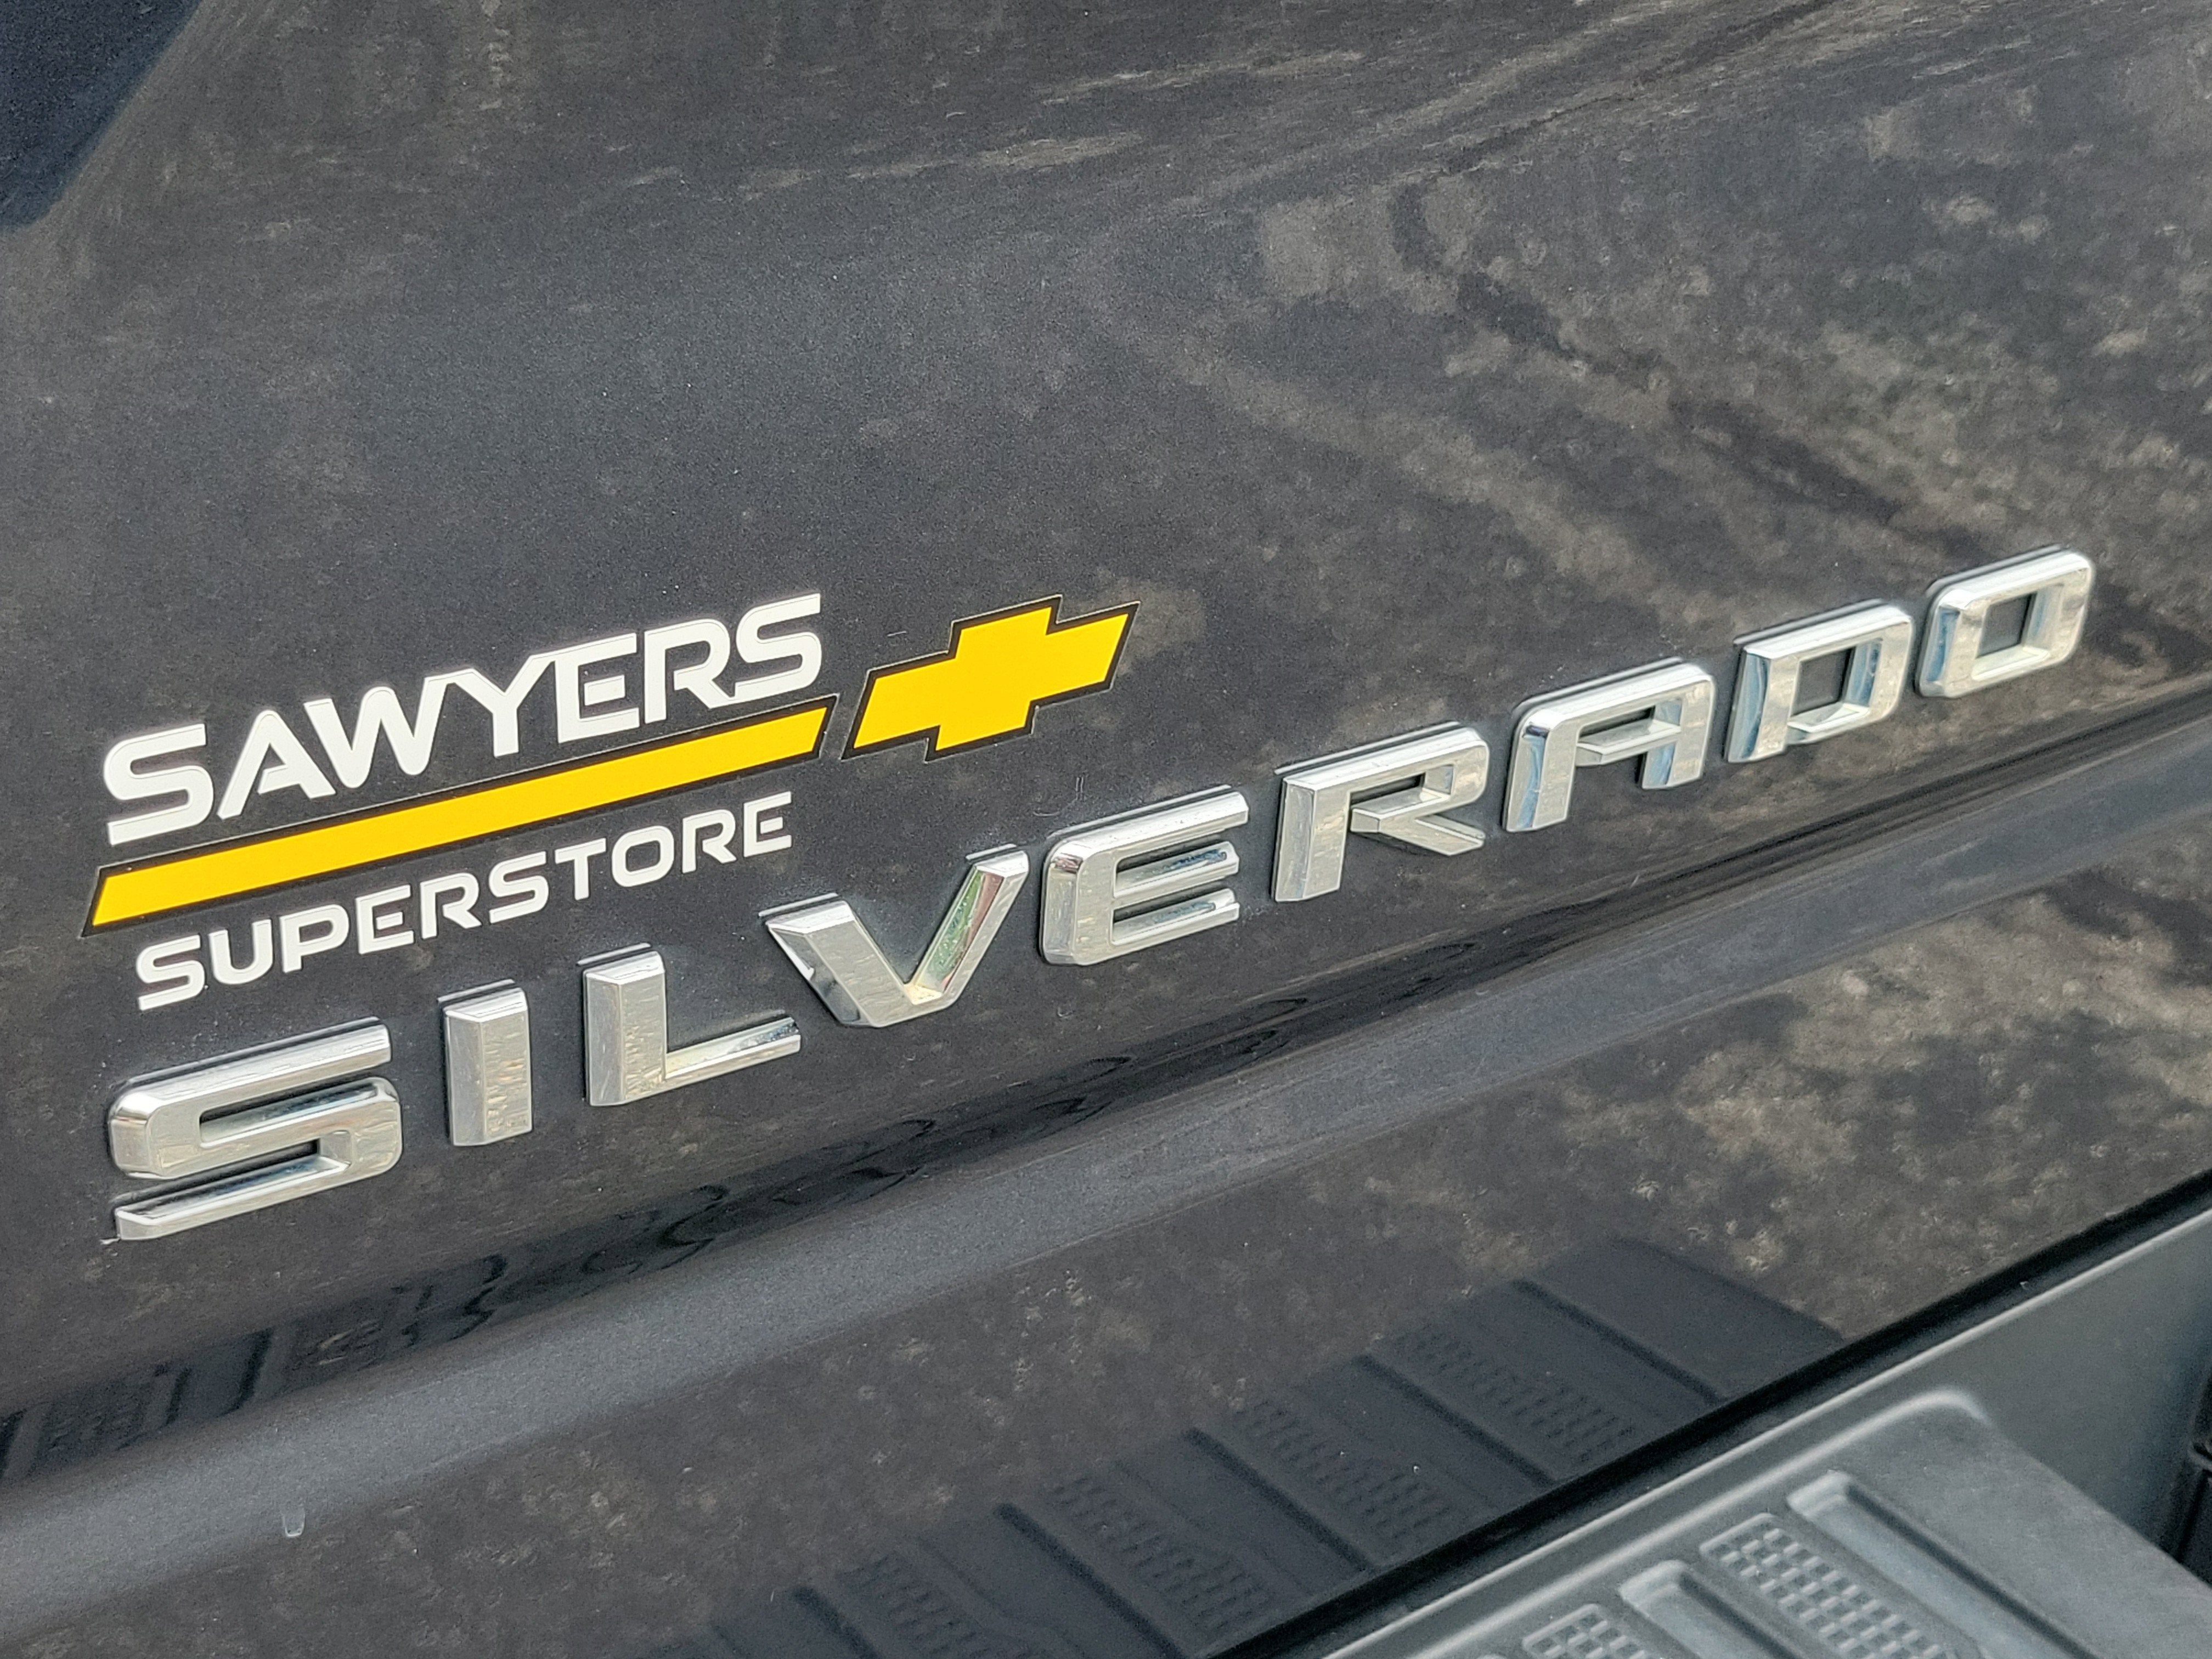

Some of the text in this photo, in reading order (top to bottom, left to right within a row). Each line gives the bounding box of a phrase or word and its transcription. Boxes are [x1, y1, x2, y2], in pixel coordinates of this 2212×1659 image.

[103, 593, 822, 845] SAWYERS
[110, 549, 2095, 1242] SILVERADO
[136, 791, 792, 1011] SUPERSTORE
